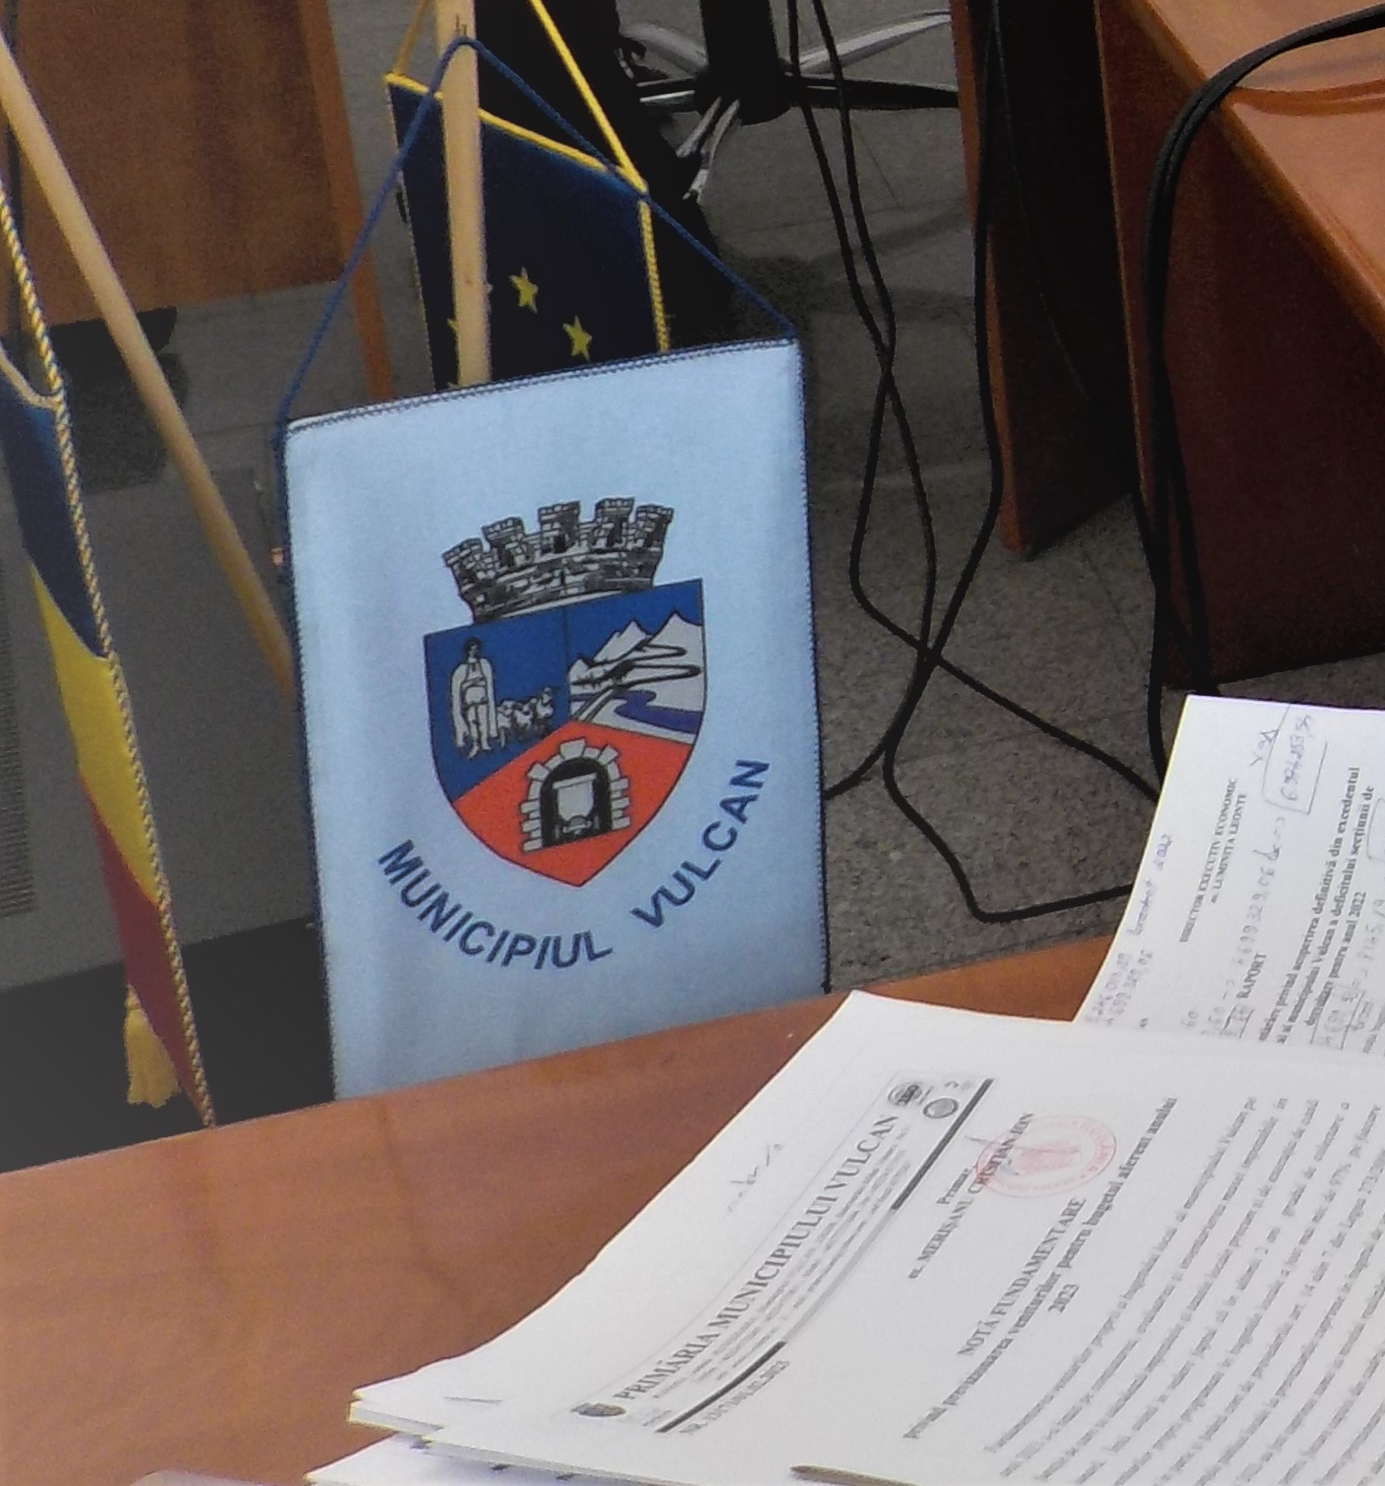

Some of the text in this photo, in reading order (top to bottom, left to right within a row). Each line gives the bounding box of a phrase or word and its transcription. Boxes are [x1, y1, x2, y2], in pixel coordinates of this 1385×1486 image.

[1334, 766, 1360, 832] excedentul
[378, 758, 770, 971] MUNICIPIUL VULCAN
[1309, 927, 1335, 964] Vulcan
[1327, 856, 1356, 917] deficitului
[1360, 785, 1376, 799] de
[1326, 835, 1344, 856] din
[1338, 919, 1357, 943] anul
[1348, 890, 1367, 917] 2022
[1236, 952, 1266, 999] RAPORT
[1082, 1181, 1123, 1227] bugetul
[1115, 1136, 1152, 1178] aferent
[612, 1327, 721, 1400] PRIMĂRIA
[707, 1194, 836, 1329] MUNICIPIULUI
[823, 1113, 900, 1188] VULCAN
[957, 1320, 1000, 1356] NOTĂ
[990, 1198, 1086, 1316] FUNDAMENTARE
